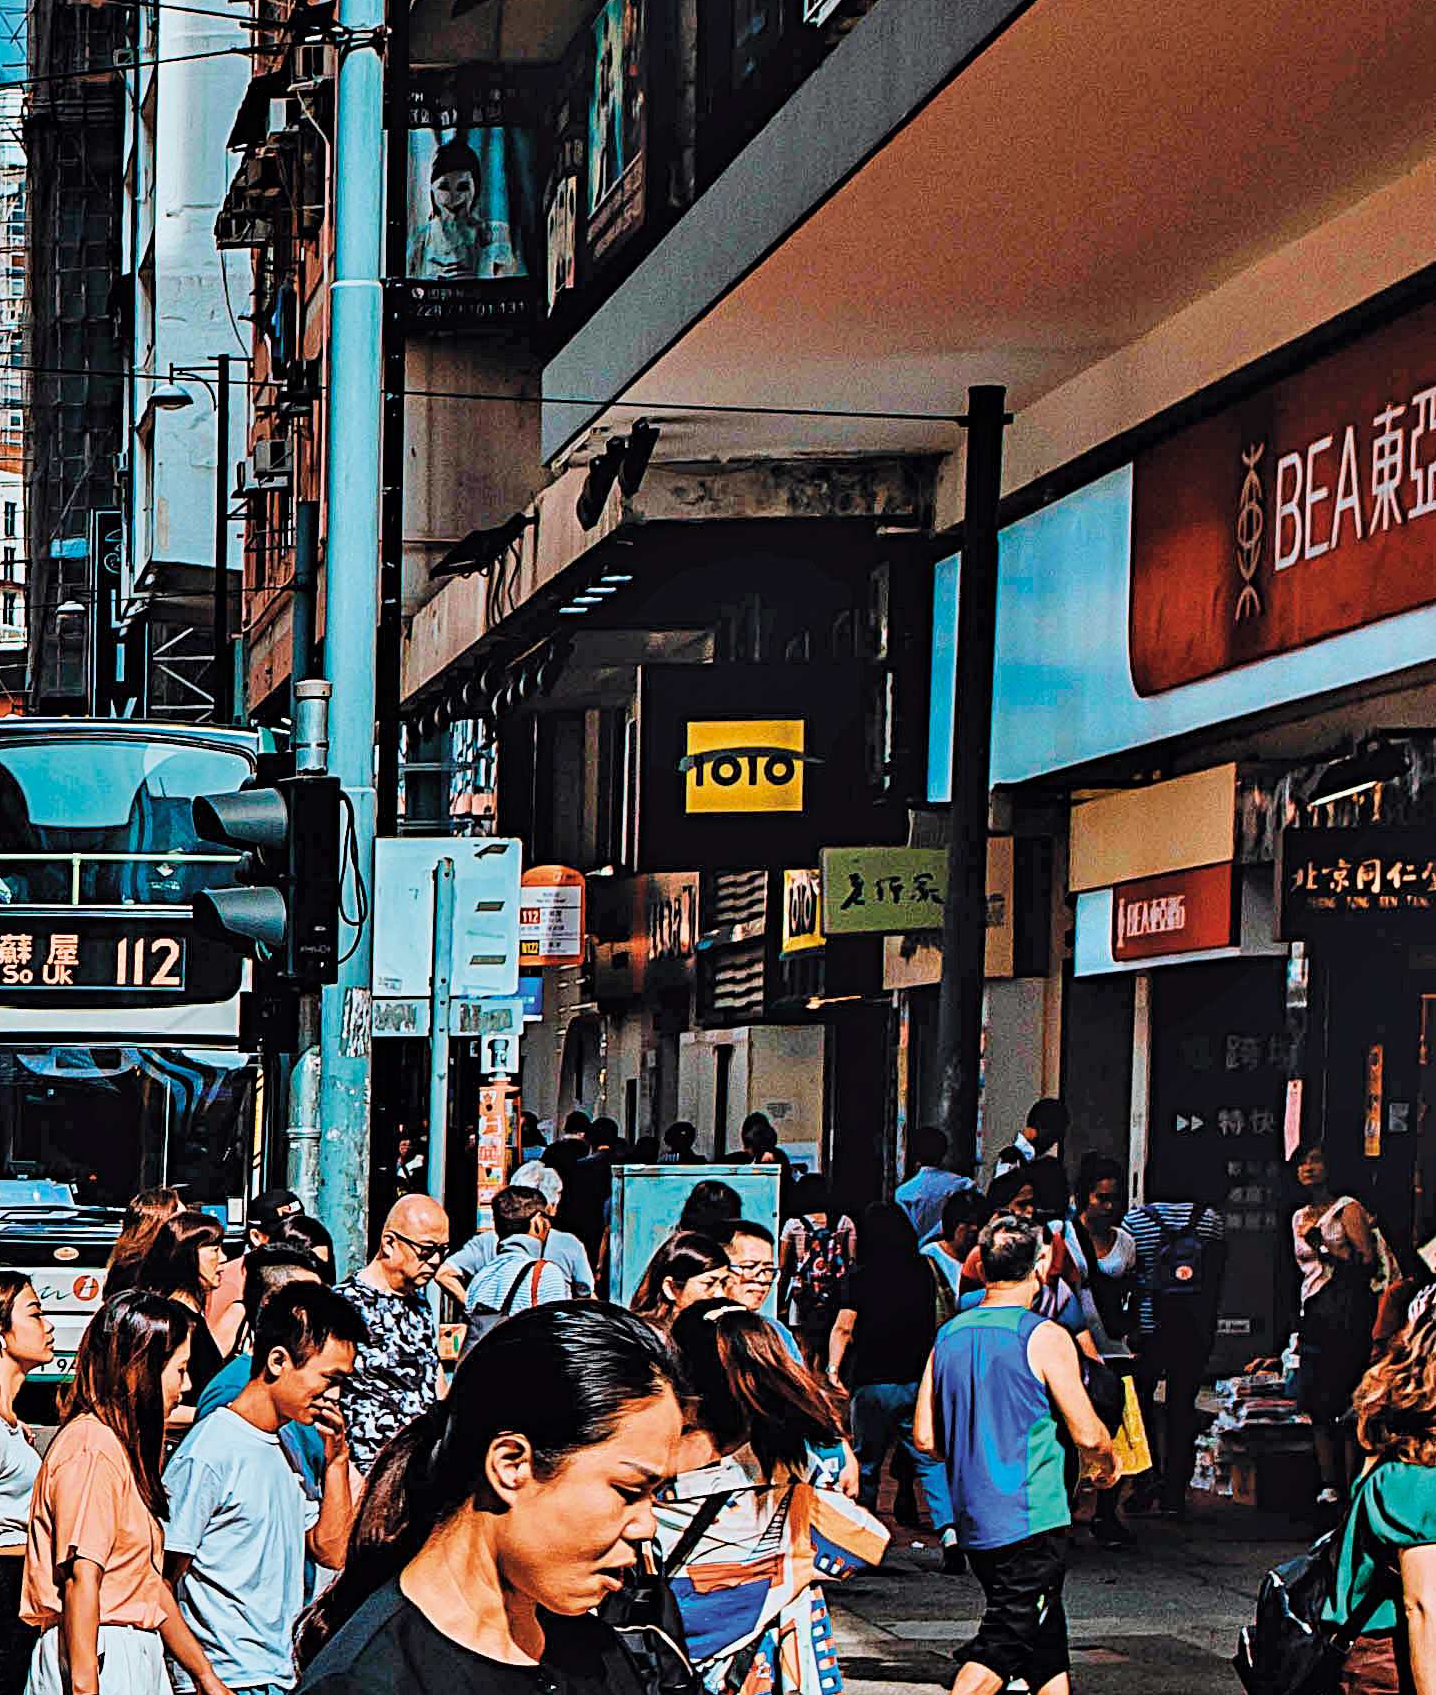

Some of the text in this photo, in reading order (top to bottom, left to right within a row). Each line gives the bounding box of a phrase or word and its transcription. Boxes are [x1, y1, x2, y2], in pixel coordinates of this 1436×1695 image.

[1273, 441, 1363, 572] BEA
[690, 753, 795, 786] TOTO
[2, 966, 74, 985] So Uk
[115, 937, 183, 987] 112
